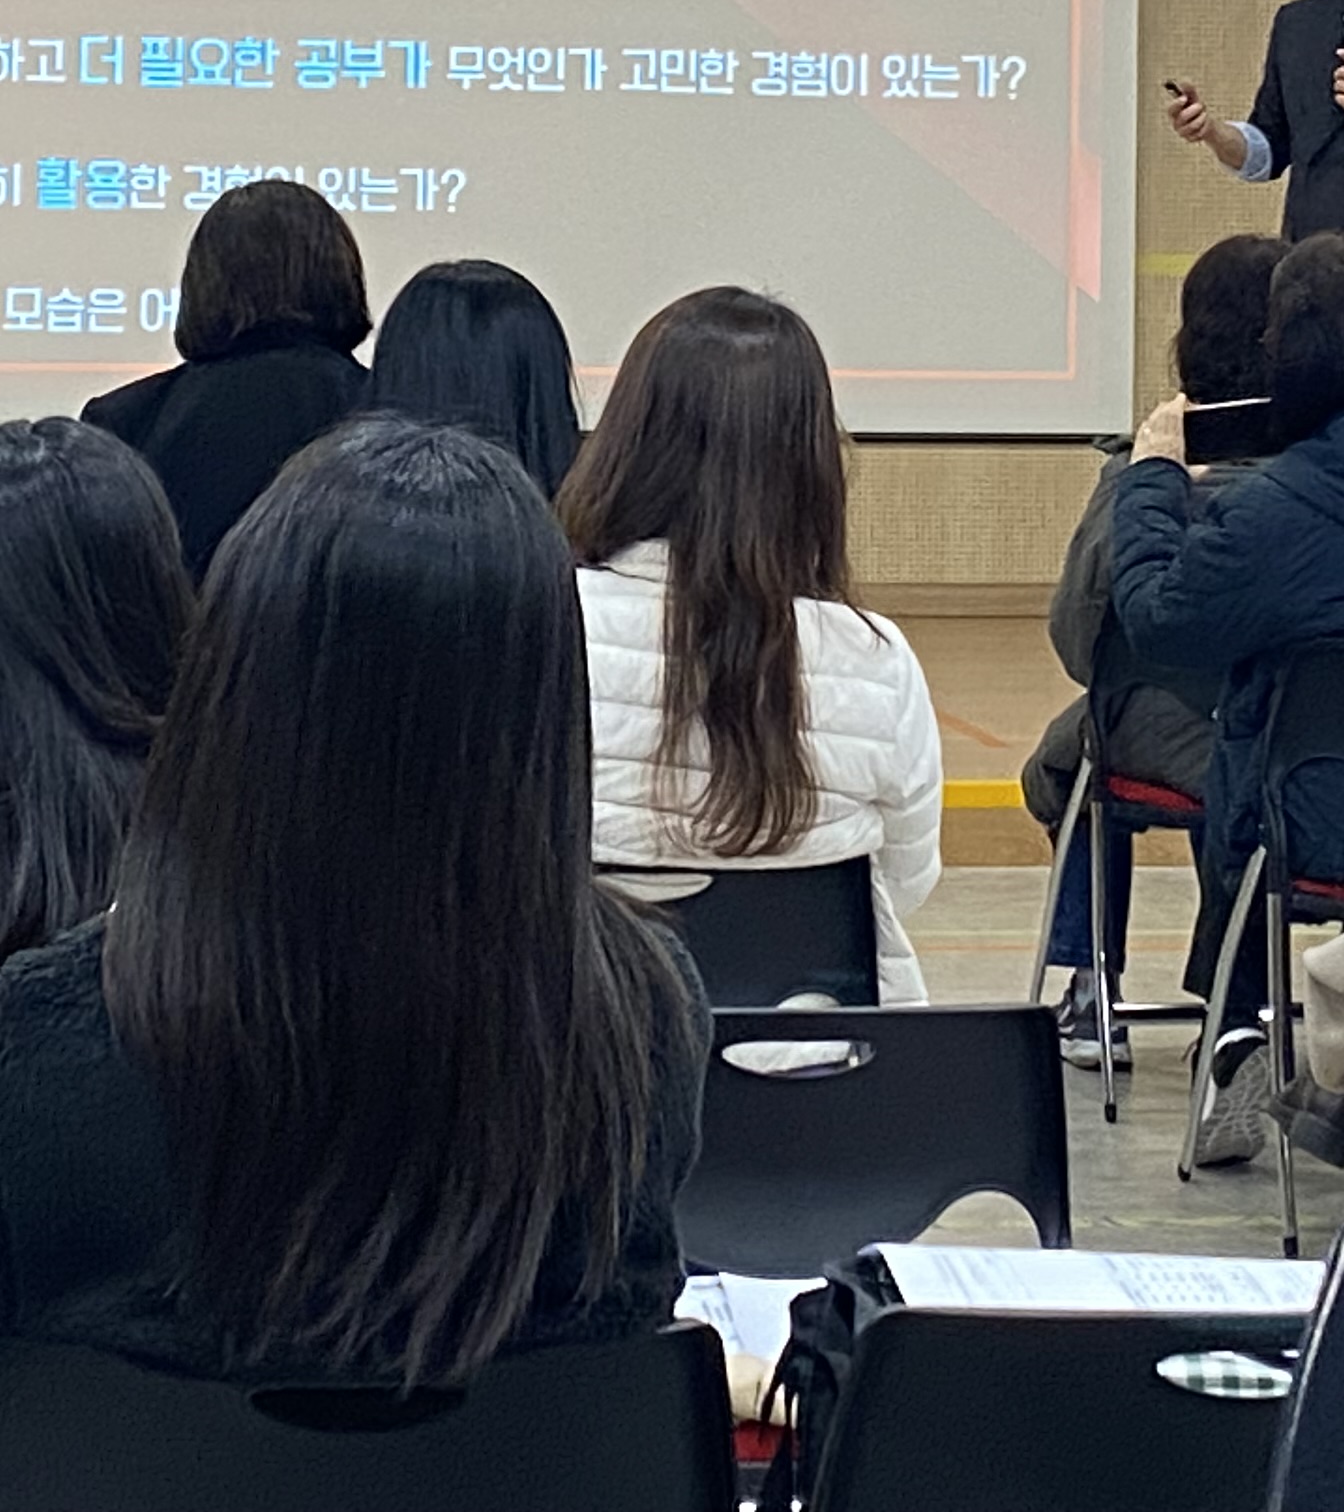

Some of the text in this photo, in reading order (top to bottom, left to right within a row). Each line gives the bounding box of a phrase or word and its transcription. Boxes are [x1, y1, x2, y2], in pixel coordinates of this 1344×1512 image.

[78, 35, 125, 86] 더
[139, 35, 281, 89] 필요한
[294, 37, 433, 90] 공부가
[447, 44, 608, 92] 무엇인가
[619, 47, 740, 95] 고민한
[750, 49, 869, 98] 경험이
[881, 53, 1027, 100] 있는가?
[36, 155, 172, 212] 활용한
[317, 164, 468, 213] 있는가?
[1, 285, 128, 336] 모습은
